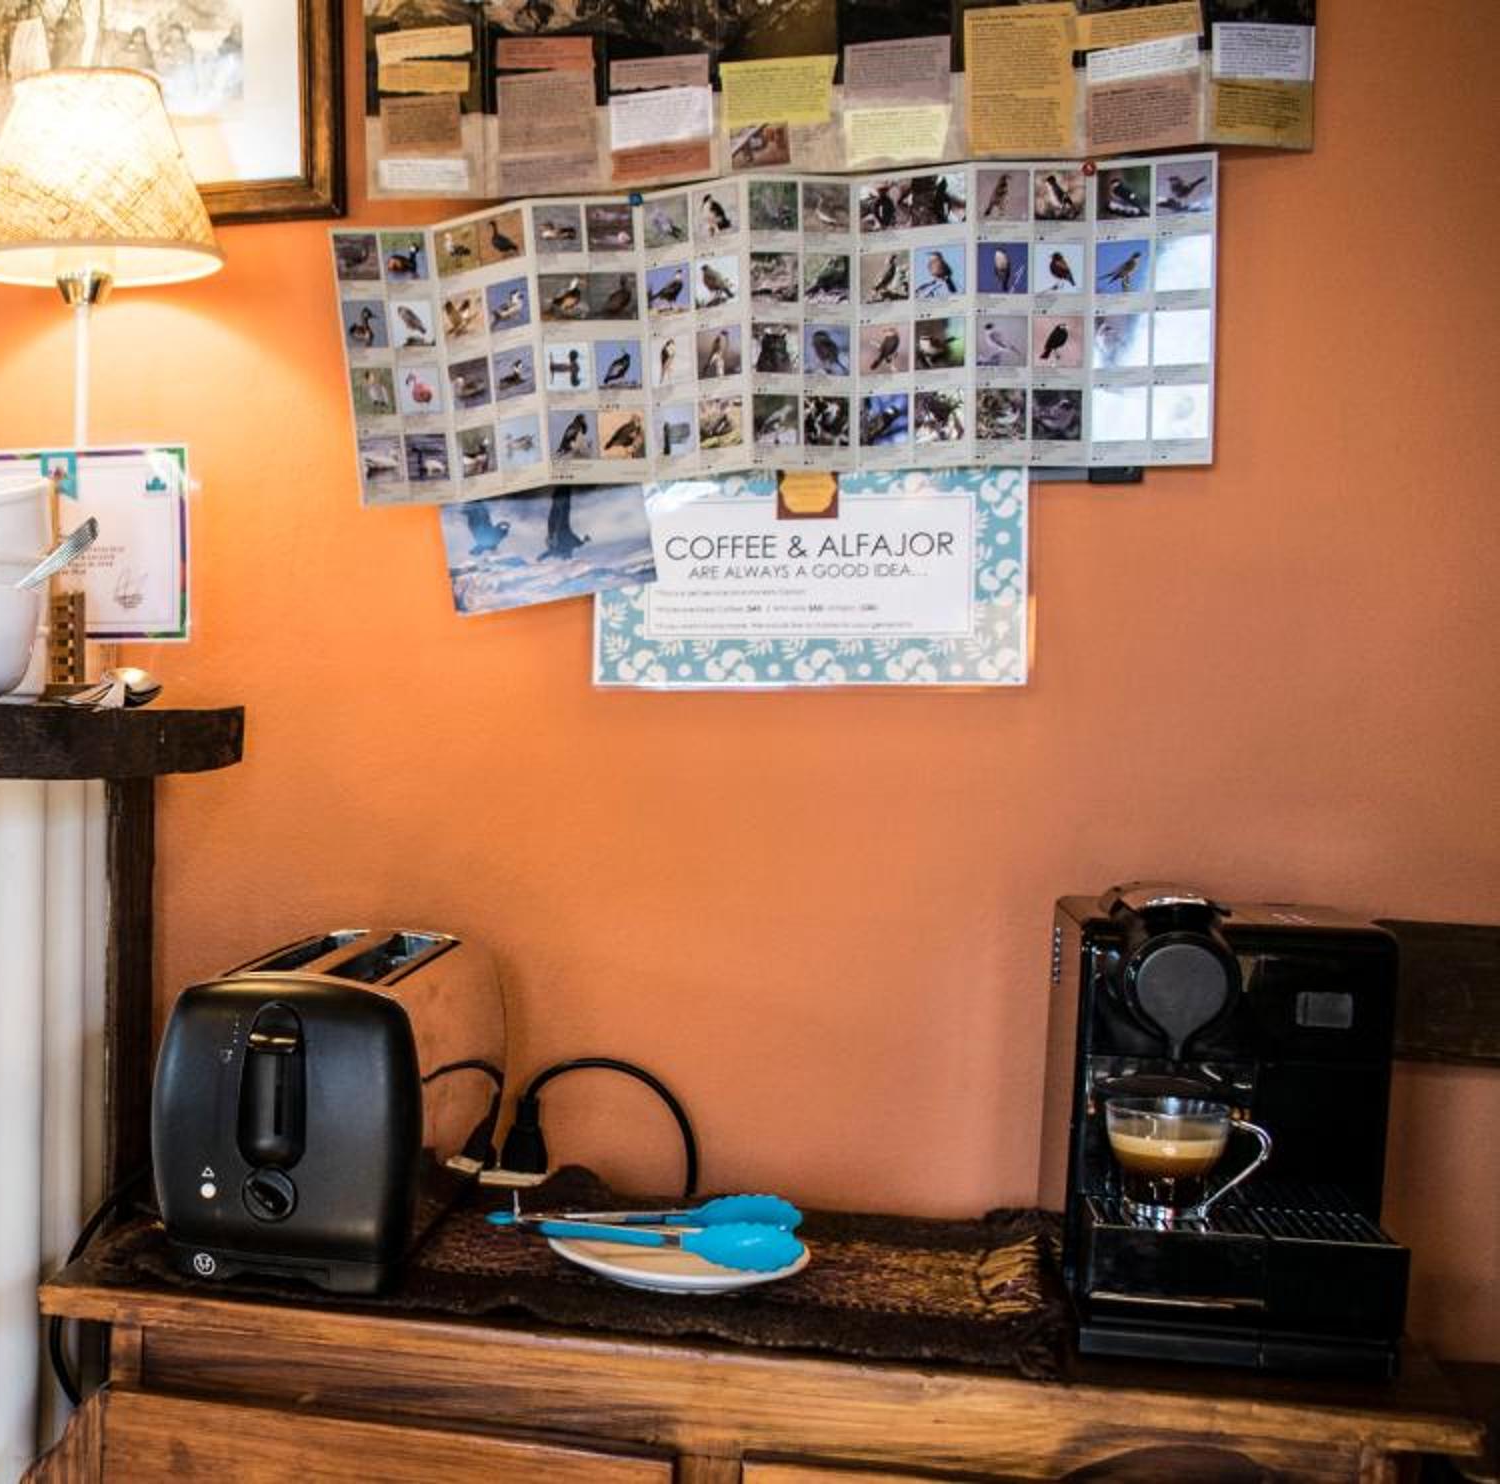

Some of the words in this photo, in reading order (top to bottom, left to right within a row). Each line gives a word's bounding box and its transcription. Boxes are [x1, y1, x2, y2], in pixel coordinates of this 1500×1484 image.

[665, 534, 778, 561] COFFEE
[787, 535, 808, 559] &
[817, 531, 954, 557] ALFAJOR
[688, 565, 719, 580] ARE
[724, 565, 790, 579] ALWAYS
[796, 564, 807, 578] A
[811, 563, 869, 578] GOOD
